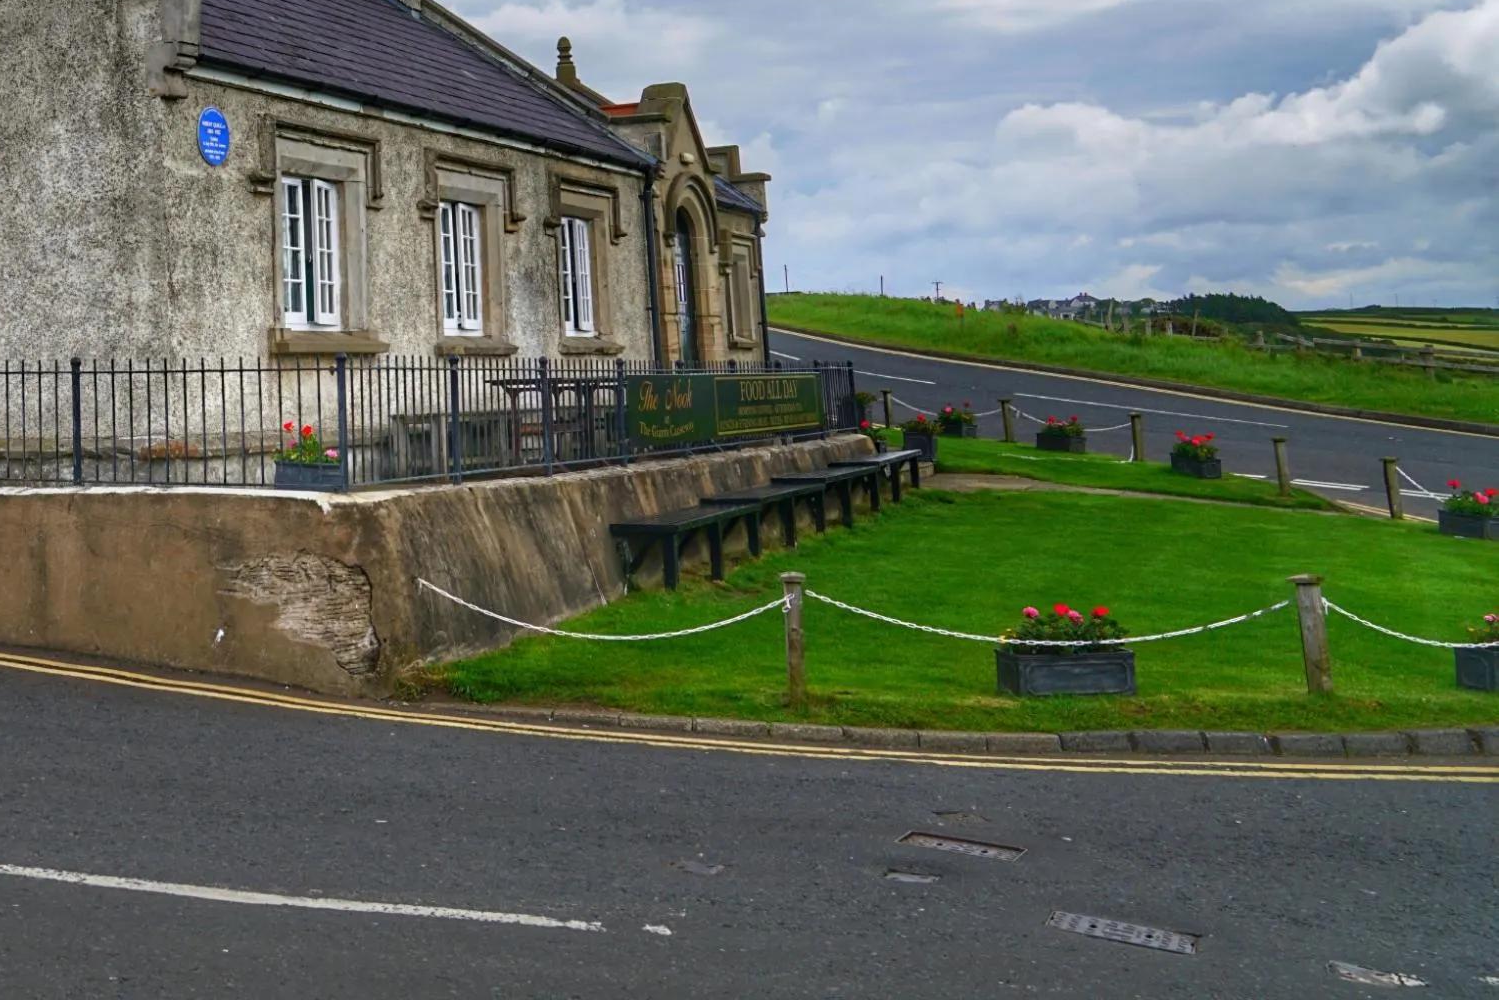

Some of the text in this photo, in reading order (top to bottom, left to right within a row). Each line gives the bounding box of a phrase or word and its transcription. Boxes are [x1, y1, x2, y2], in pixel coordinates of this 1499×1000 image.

[638, 380, 658, 412] The
[740, 379, 798, 401] FOOD ALL DAY
